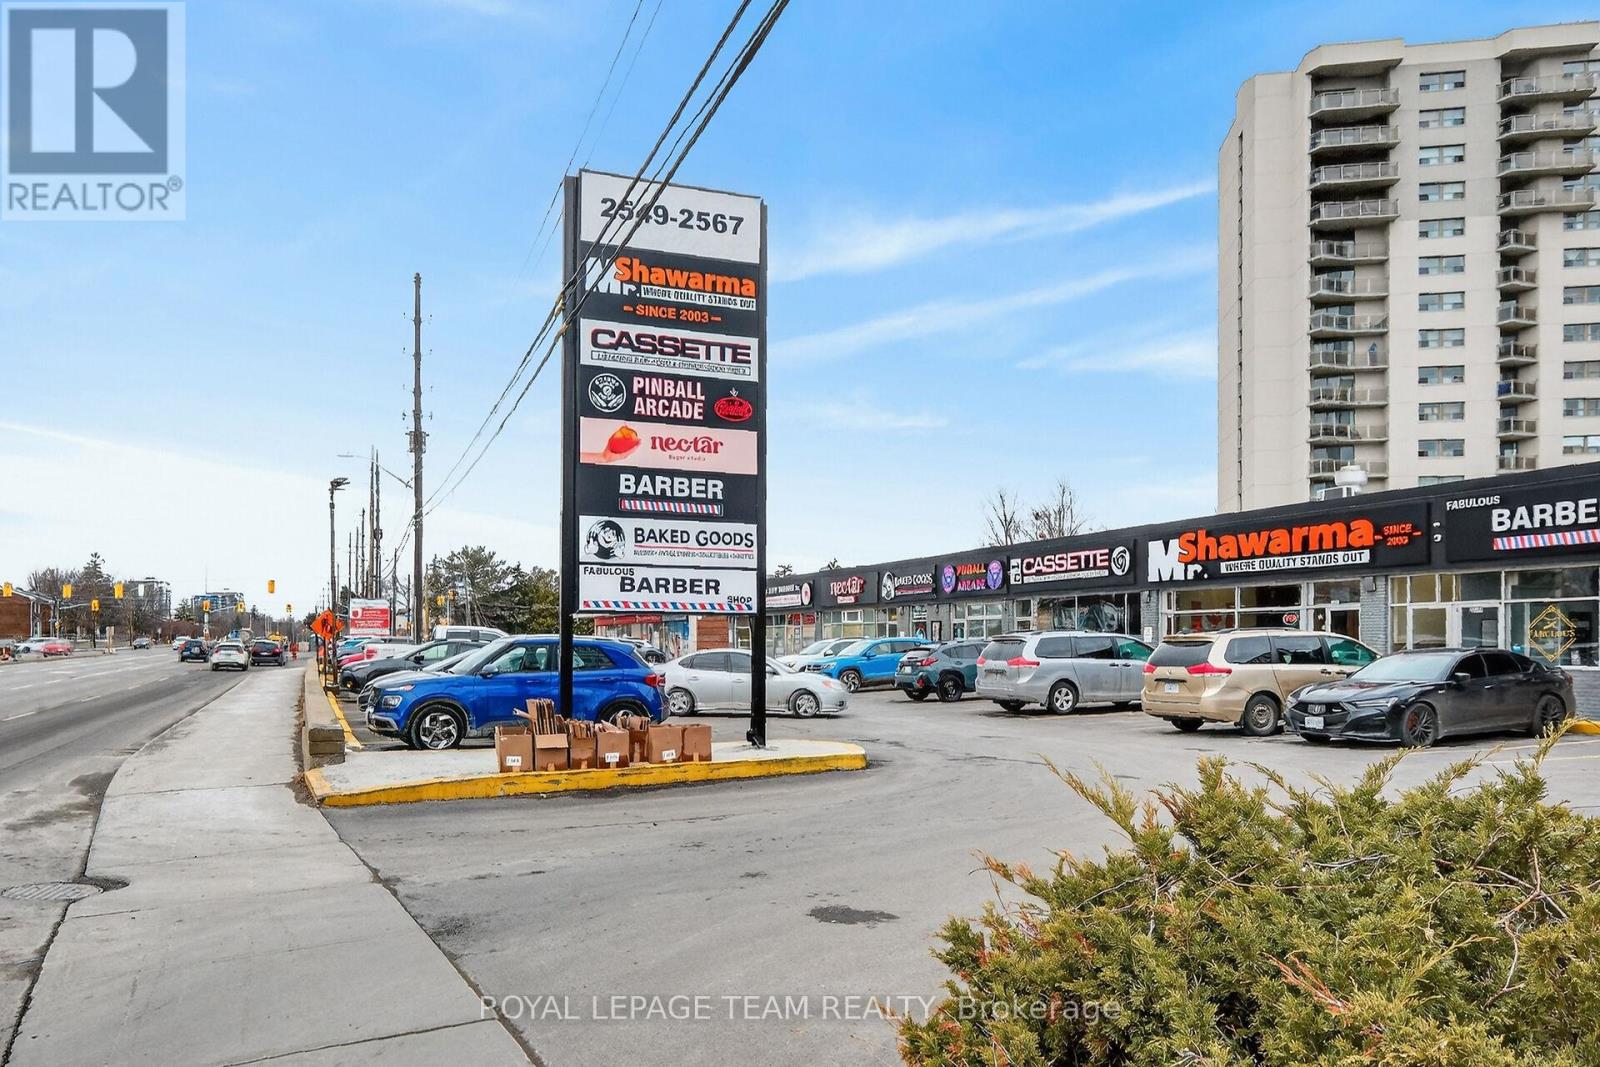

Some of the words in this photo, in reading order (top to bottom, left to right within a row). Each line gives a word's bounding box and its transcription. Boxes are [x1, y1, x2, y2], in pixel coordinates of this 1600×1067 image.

[585, 256, 641, 298] Mr.
[614, 256, 757, 298] Shawarma
[635, 304, 677, 320] SINCE
[679, 309, 709, 323] 2003
[590, 327, 752, 366] CASSETTE
[633, 376, 705, 400] PINBALL
[634, 397, 704, 420] ARCADE
[650, 435, 724, 454] nectar
[619, 473, 724, 500] BARBER
[1446, 495, 1501, 511] FABULOUS
[1491, 498, 1600, 532] BARBE
[634, 527, 691, 544] BAKED
[695, 530, 754, 548] GOODS
[1383, 523, 1413, 536] SINCE
[1178, 518, 1375, 564] Shawarma
[1022, 549, 1110, 575] CASSETTE
[1147, 539, 1209, 582] Mr.
[1300, 554, 1339, 568] STANDS
[1342, 551, 1365, 563] OUT
[583, 566, 635, 576] FABULOUS
[619, 576, 721, 595] BARBER
[830, 576, 864, 596] nectar
[727, 595, 752, 604] SHOP
